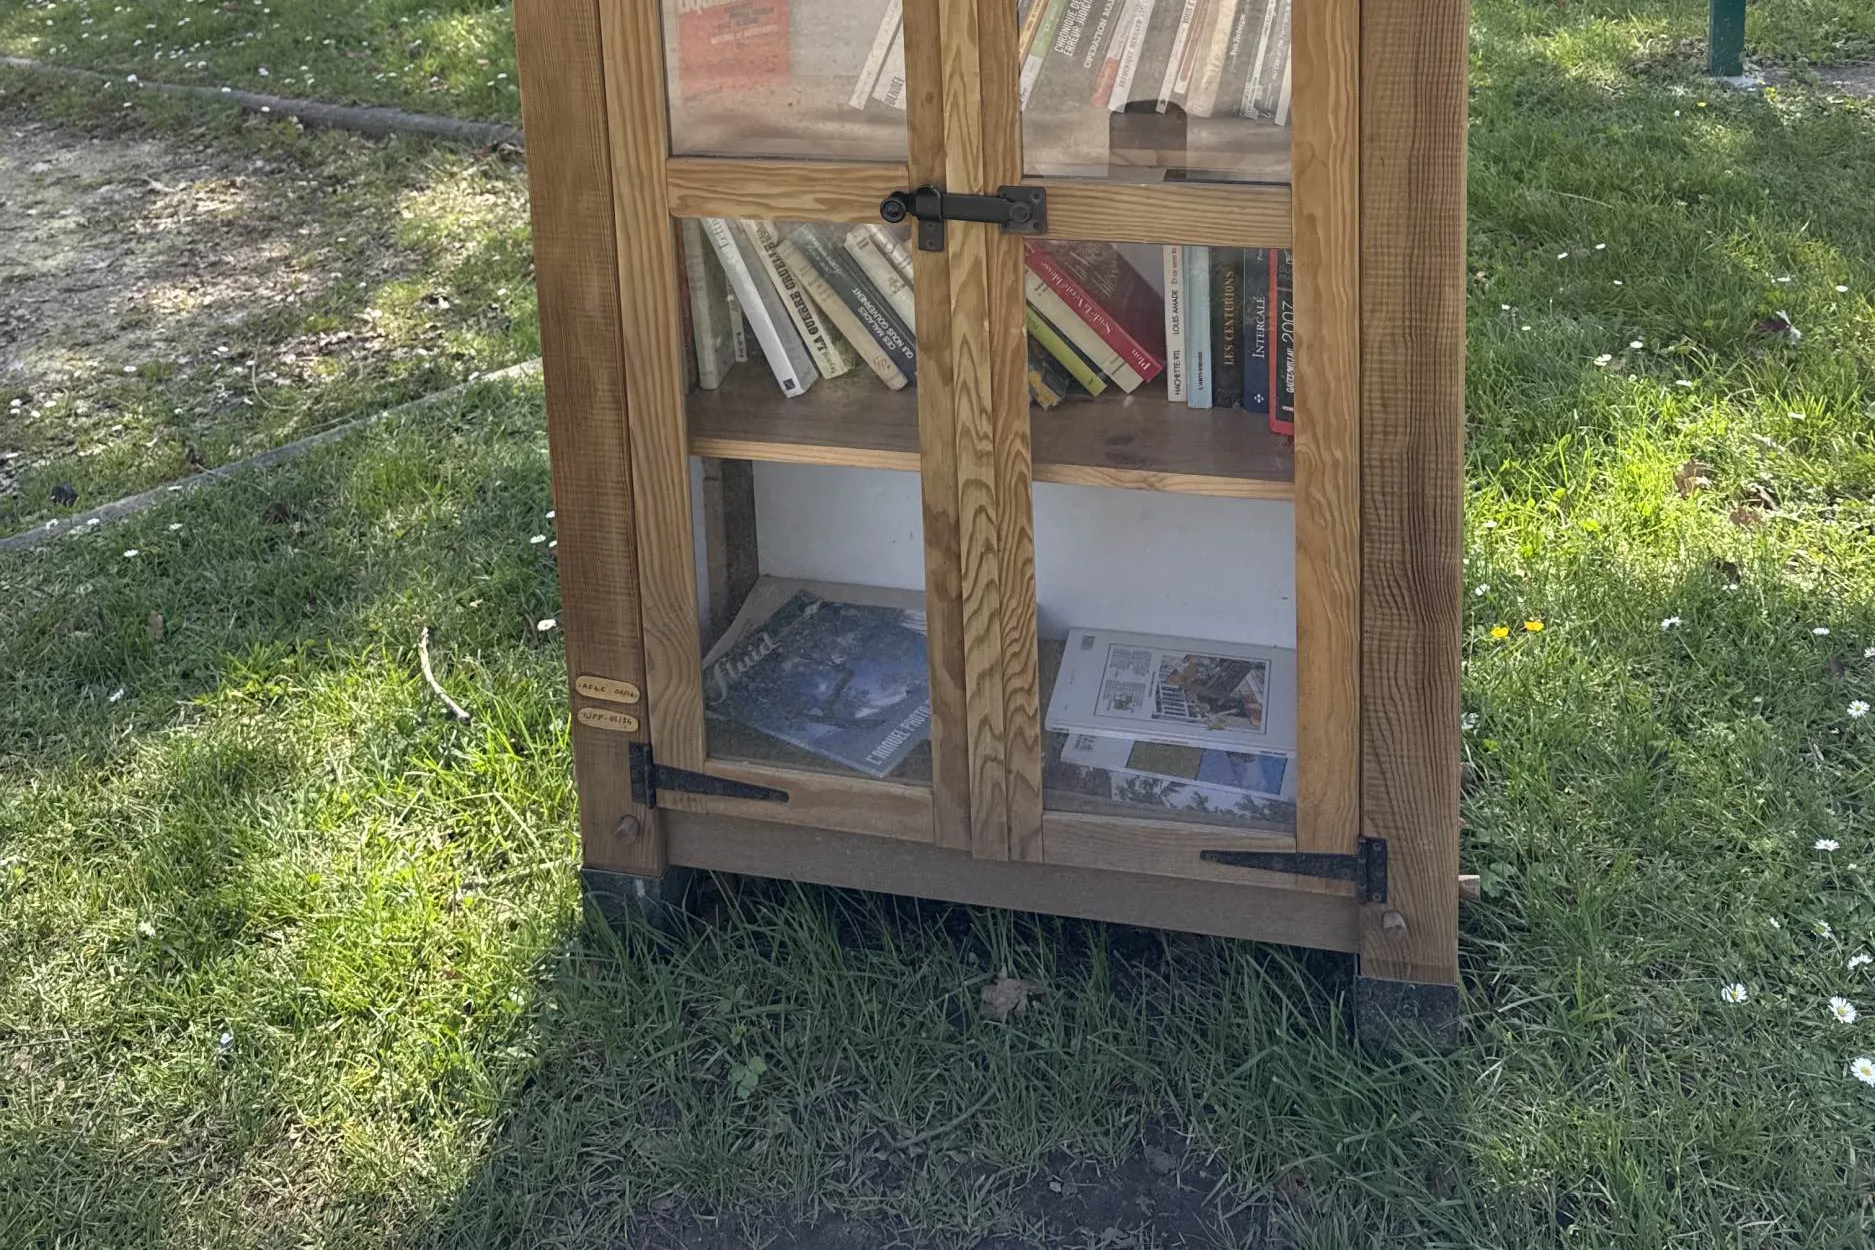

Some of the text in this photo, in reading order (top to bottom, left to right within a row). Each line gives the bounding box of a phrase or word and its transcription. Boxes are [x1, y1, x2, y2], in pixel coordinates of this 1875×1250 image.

[1054, 10, 1076, 51] CHRONIQUE
[1063, 25, 1082, 56] ERREUR
[762, 242, 798, 289] CRUELLE
[787, 290, 821, 334] GUERRE
[852, 283, 913, 359] QUI NOUS GOUVERNENT
[858, 304, 882, 337] MALADES
[1222, 270, 1234, 365] LES CENTURIONS
[812, 335, 827, 351] LA
[883, 334, 896, 350] CES
[1129, 349, 1150, 369] Plon
